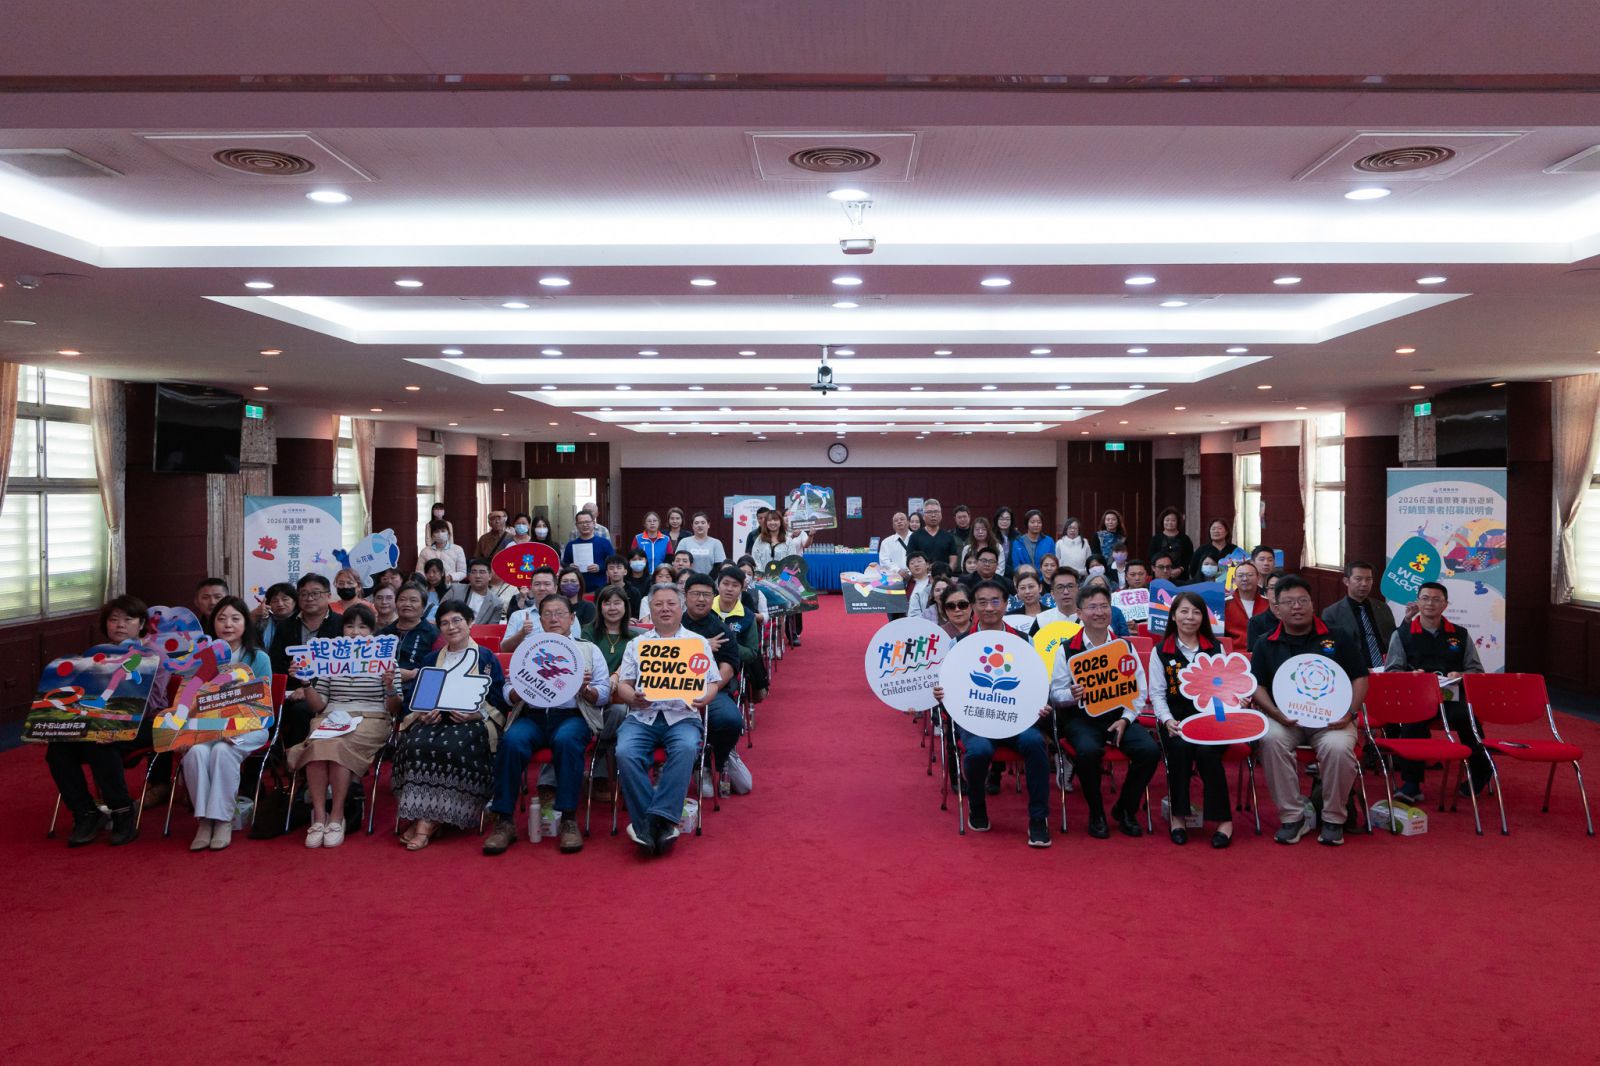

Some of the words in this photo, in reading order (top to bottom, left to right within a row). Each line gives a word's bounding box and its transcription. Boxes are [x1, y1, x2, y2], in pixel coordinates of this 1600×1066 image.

[1397, 566, 1424, 586] WE
[288, 637, 396, 661] 一起遊花蓮
[640, 644, 681, 658] 2026
[317, 659, 392, 675] HUALIEN
[639, 660, 688, 675] CCWC
[691, 655, 709, 670] in
[1073, 654, 1109, 675] 2026
[637, 675, 706, 692] HUALIEN
[880, 673, 939, 689] INTERNATION
[1077, 668, 1119, 689] CCWC
[881, 682, 923, 697] Children's
[968, 688, 1017, 706] Hualien
[1080, 679, 1138, 706] HUALIEN
[211, 697, 247, 708] Longitudinal
[246, 693, 264, 701] Valley
[1288, 702, 1332, 717] HUALIEN
[963, 704, 1019, 724] 花蓮縣政府
